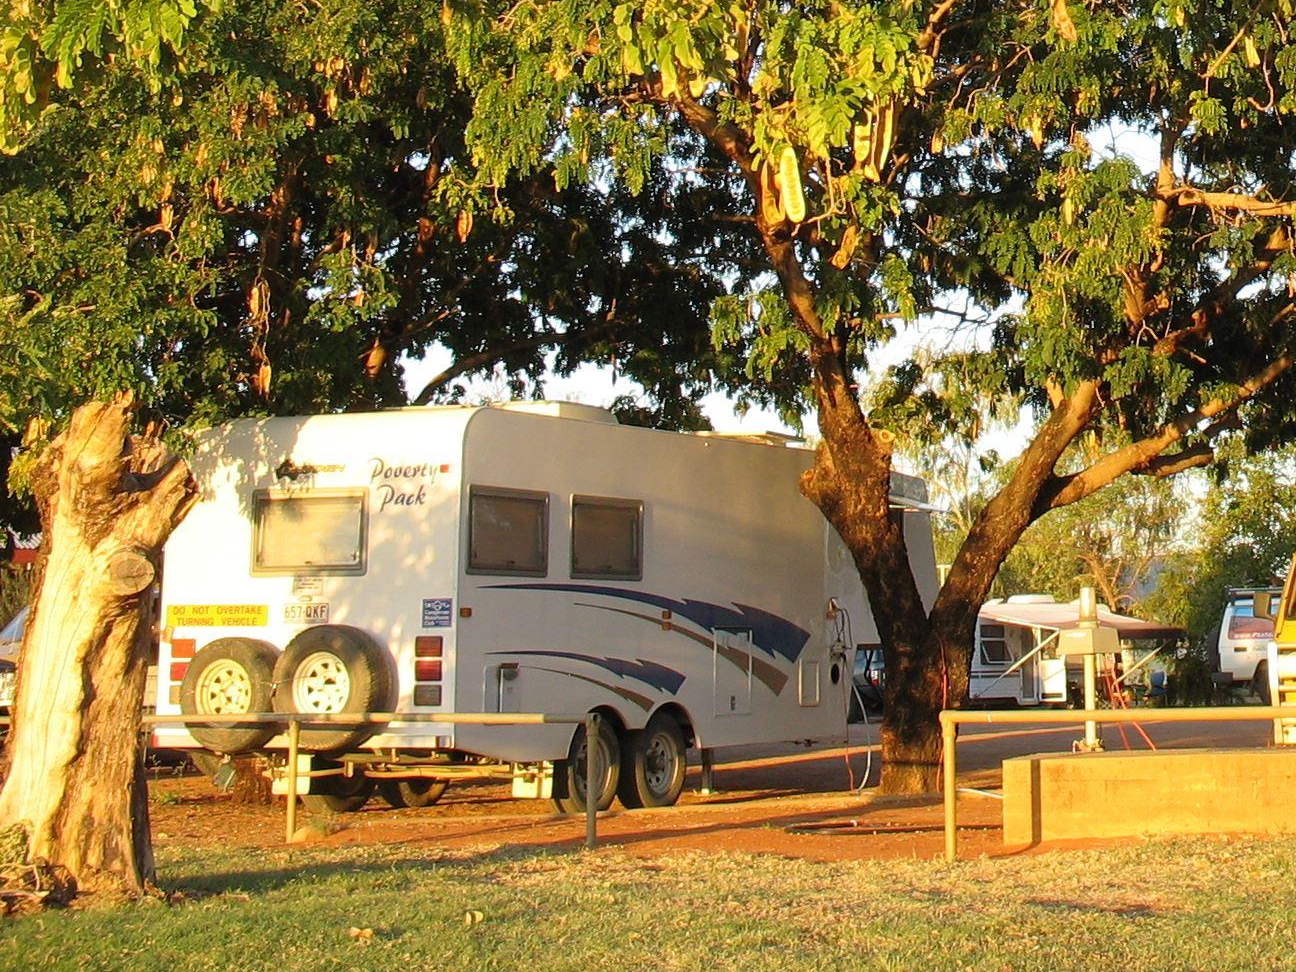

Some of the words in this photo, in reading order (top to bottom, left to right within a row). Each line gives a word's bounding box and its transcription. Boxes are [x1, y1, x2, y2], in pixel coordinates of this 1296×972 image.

[367, 457, 438, 484] Poverty
[376, 484, 427, 513] Pack
[172, 606, 186, 615] DO
[191, 606, 211, 615] NOT
[216, 605, 263, 615] OVERTAKE
[177, 617, 214, 627] TURNING
[221, 617, 258, 627] VEHICLE
